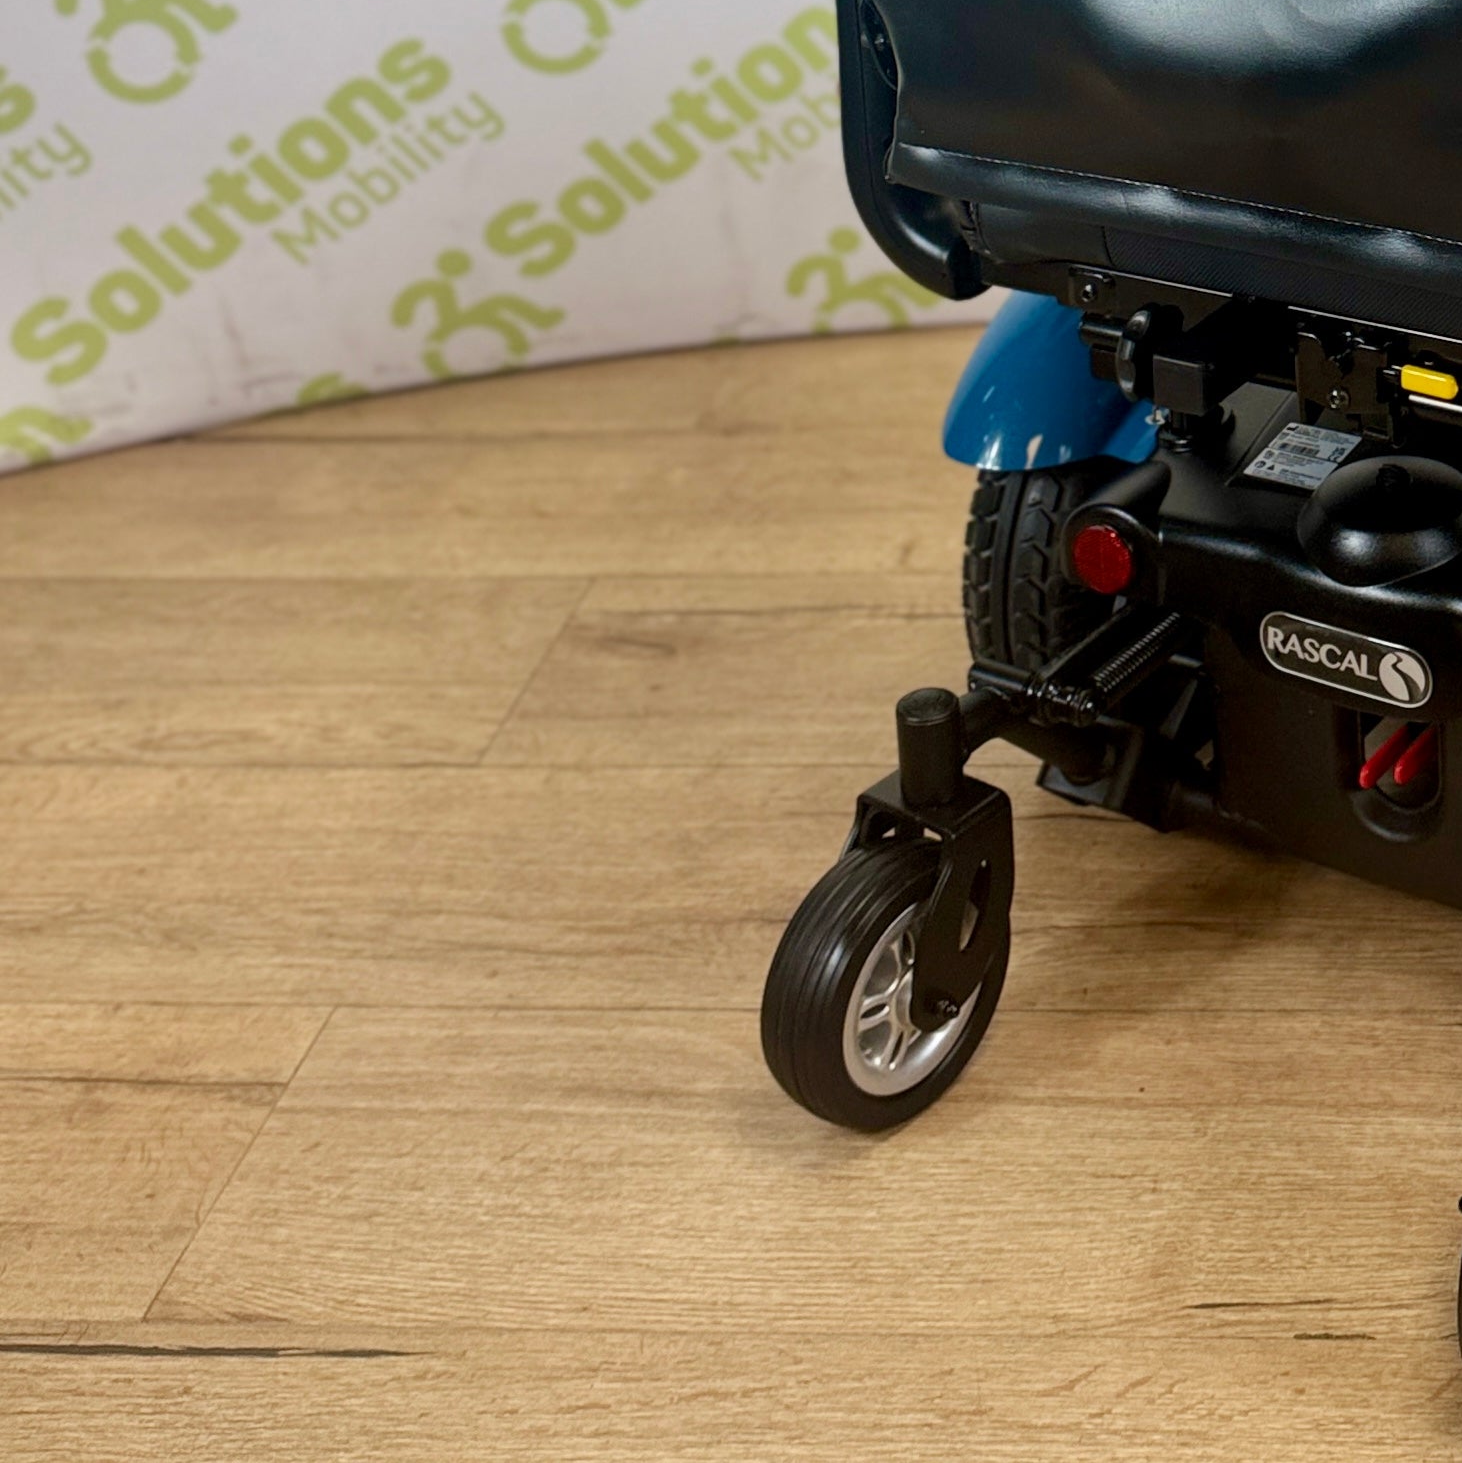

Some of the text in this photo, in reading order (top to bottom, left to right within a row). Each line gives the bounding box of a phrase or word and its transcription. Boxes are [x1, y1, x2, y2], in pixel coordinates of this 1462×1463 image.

[10, 38, 452, 386] Solutions
[271, 91, 505, 265] Mobility
[1267, 626, 1378, 681] RASCAL
